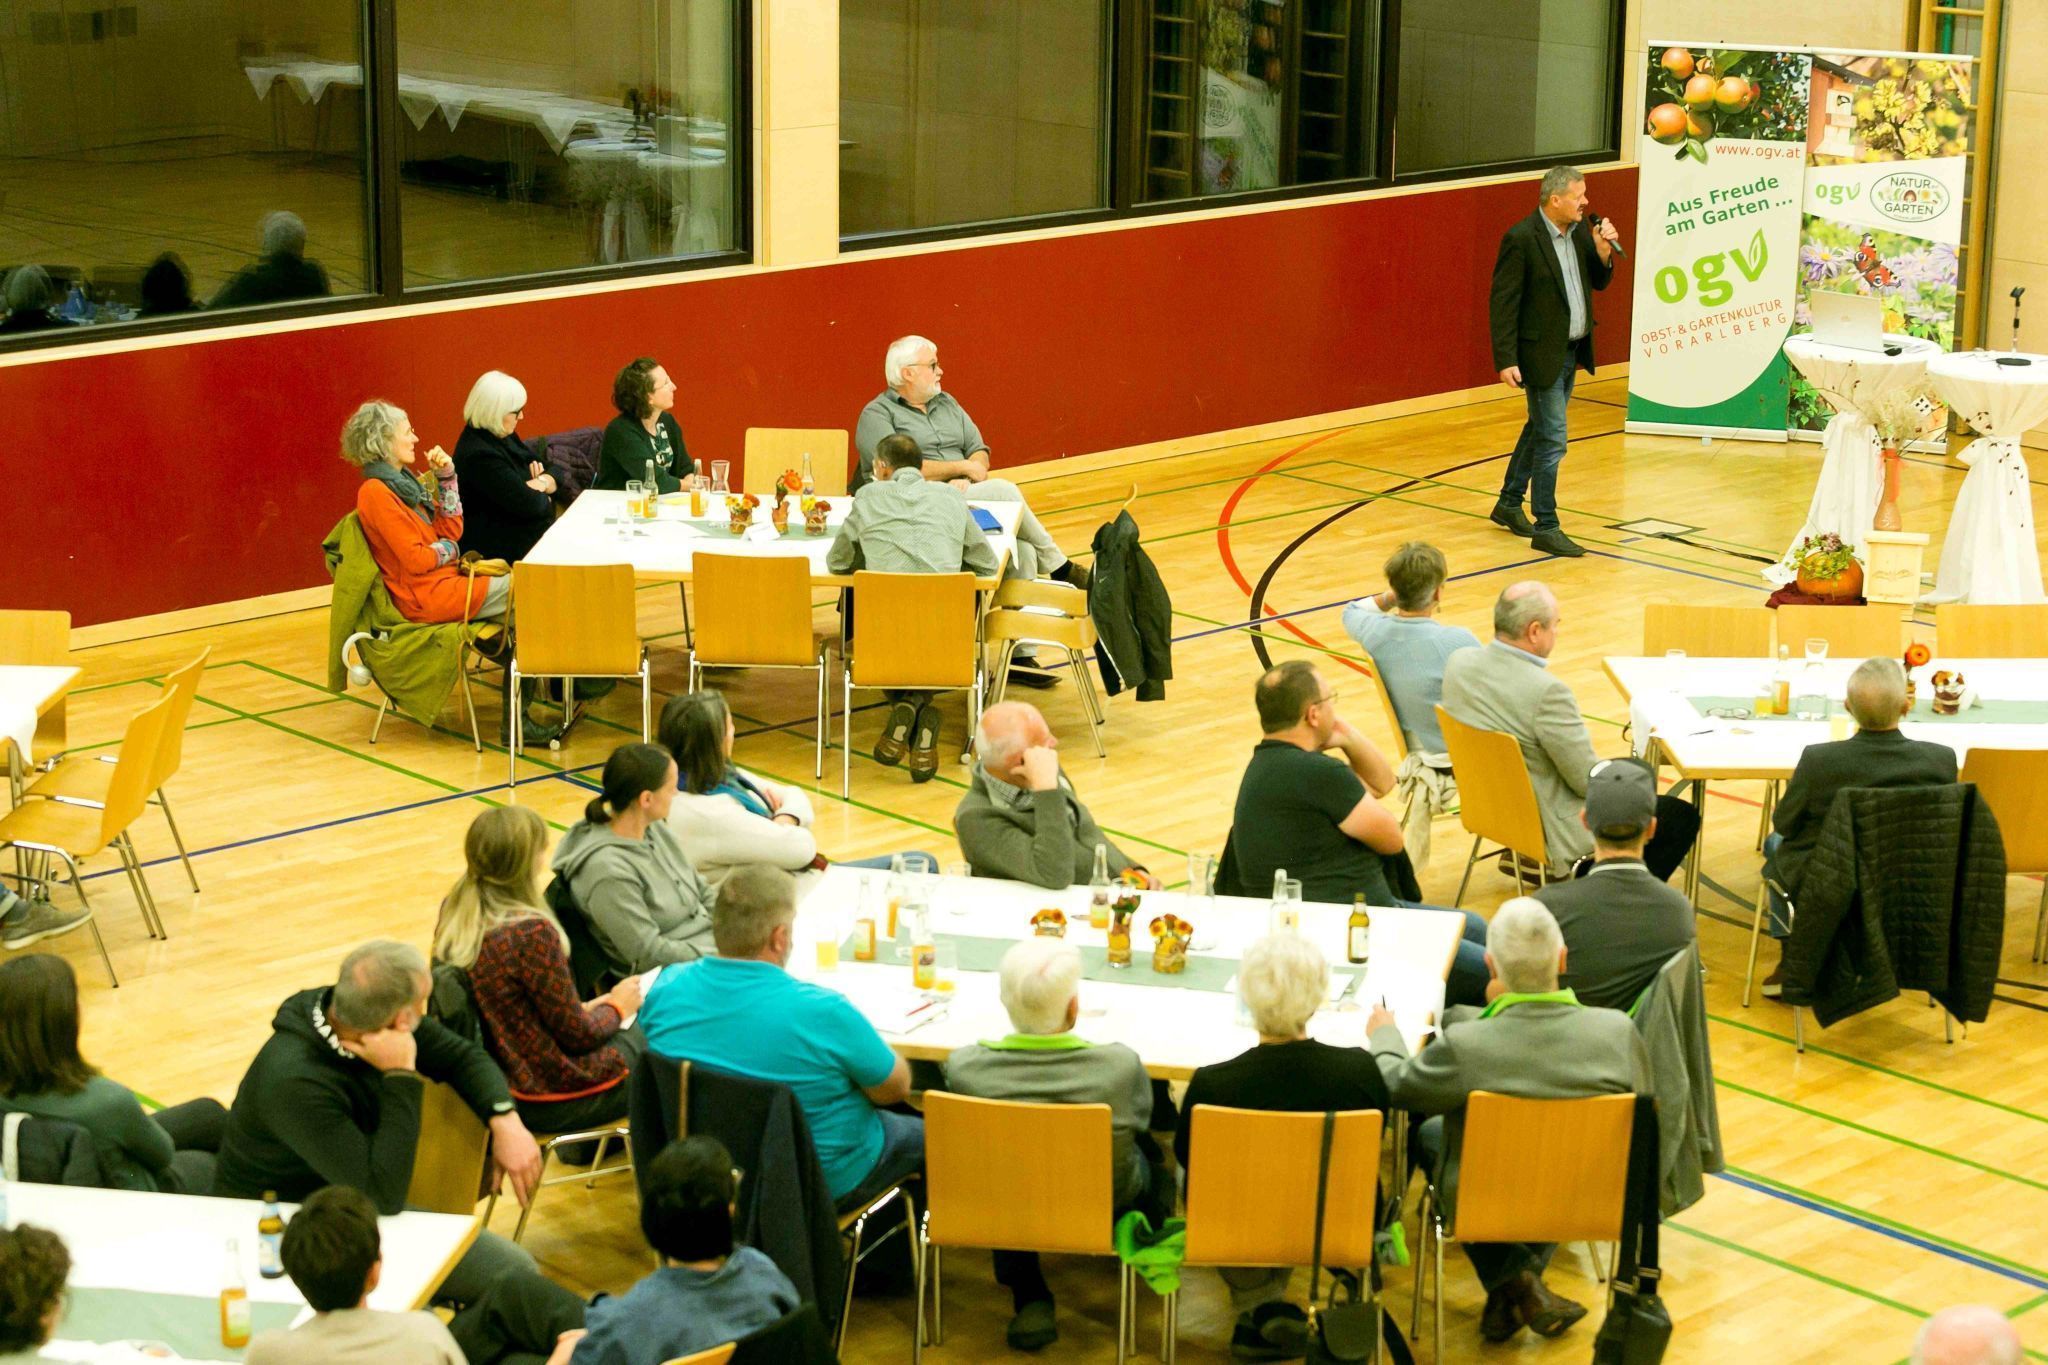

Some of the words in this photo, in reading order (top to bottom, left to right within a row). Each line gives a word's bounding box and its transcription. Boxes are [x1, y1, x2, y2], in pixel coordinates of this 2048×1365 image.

[1715, 145, 1801, 160] www.ogv.at
[1667, 197, 1704, 217] Aus
[1709, 176, 1780, 205] Freude
[1815, 182, 1861, 205] ogv
[1890, 177, 1931, 189] NATUR
[1665, 219, 1696, 236] am
[1702, 199, 1770, 226] Garten
[1884, 202, 1934, 215] GARTEN
[1653, 227, 1769, 307] ogv
[1678, 324, 1688, 335] &
[1689, 299, 1783, 331] GARTENKULTUR
